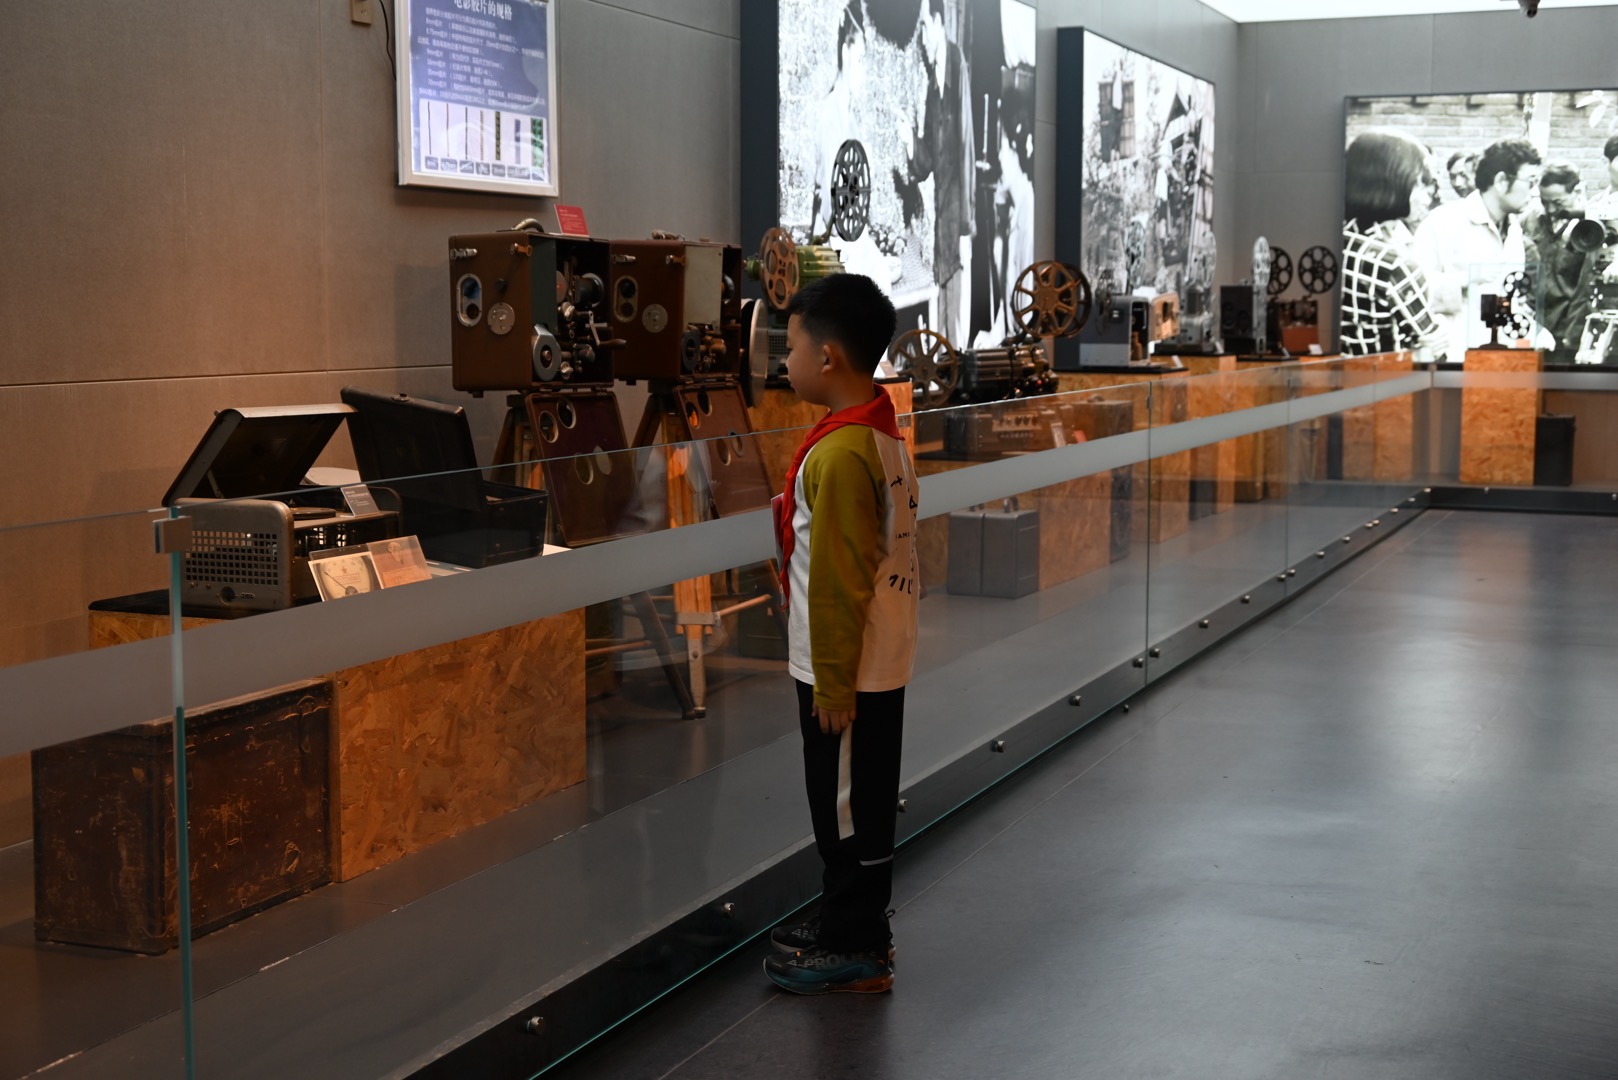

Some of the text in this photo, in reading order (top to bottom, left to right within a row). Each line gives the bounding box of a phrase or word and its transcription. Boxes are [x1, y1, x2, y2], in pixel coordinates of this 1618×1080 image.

[454, 0, 513, 20] 电影胶片的规格
